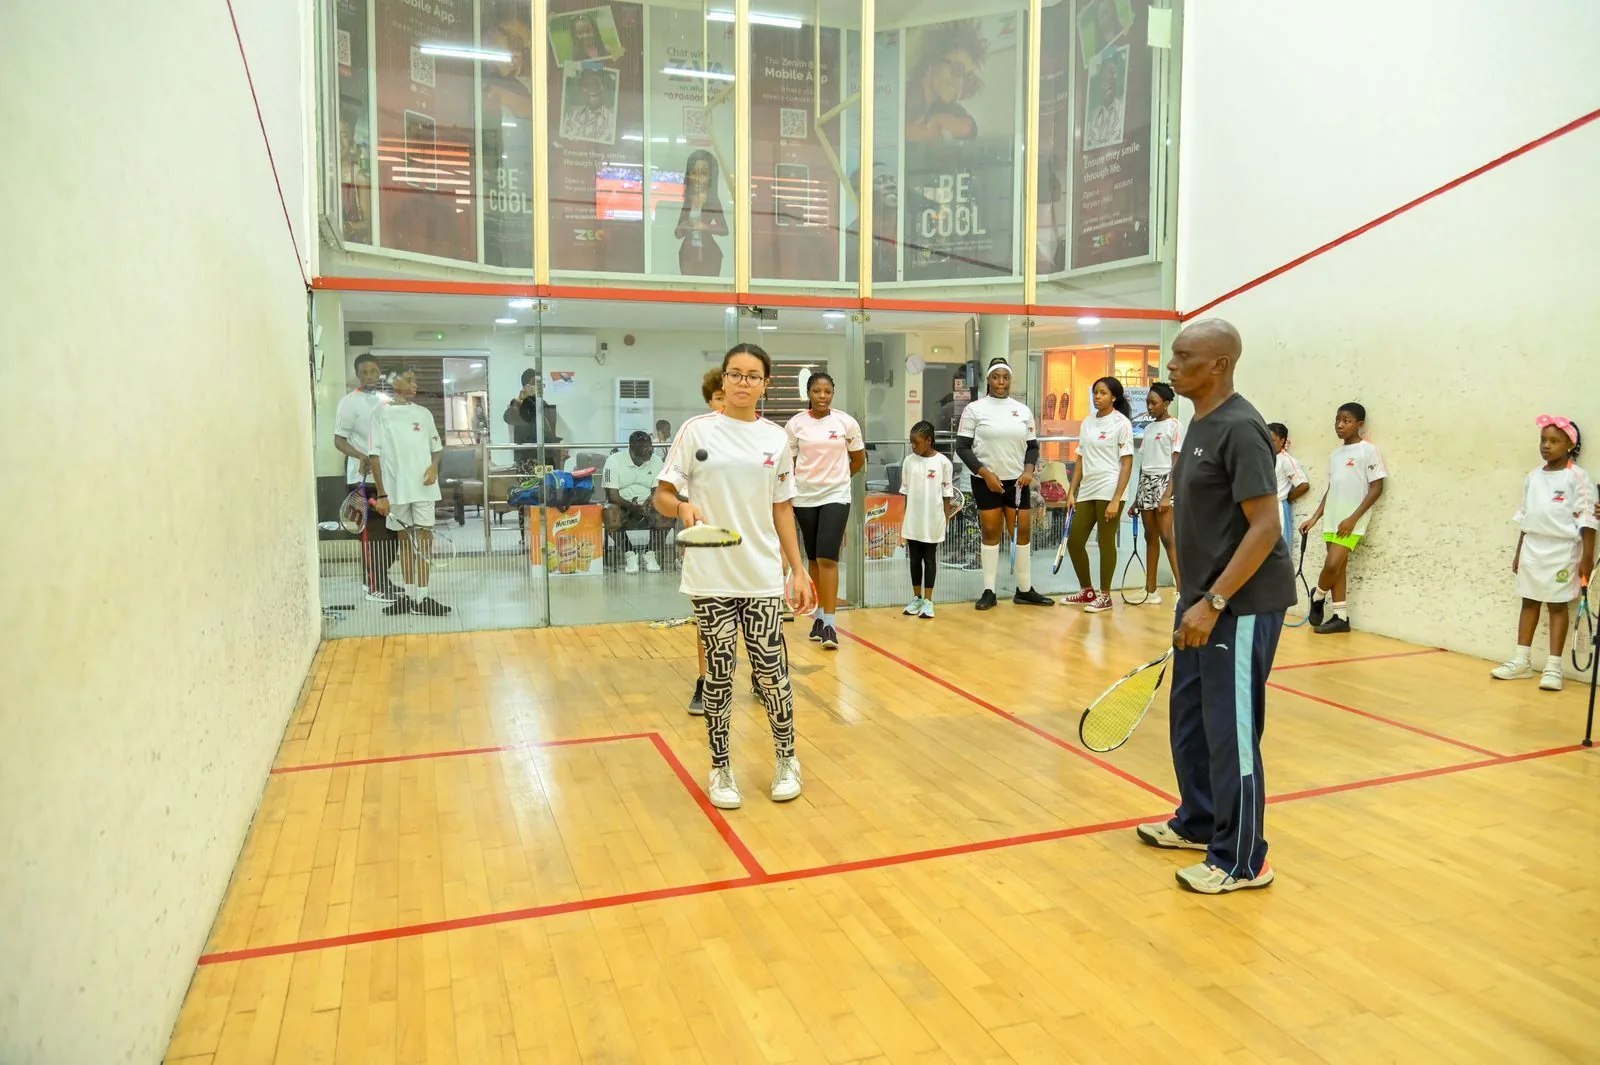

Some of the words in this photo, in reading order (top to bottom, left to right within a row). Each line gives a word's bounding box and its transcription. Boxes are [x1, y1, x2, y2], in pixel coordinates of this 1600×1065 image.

[400, 0, 432, 13] obile
[433, 5, 455, 25] App
[666, 46, 688, 57] Chat
[781, 57, 807, 69] Zenith
[764, 66, 804, 81] Mobile
[806, 71, 829, 85] Ap
[1084, 156, 1105, 169] Ensure
[1105, 151, 1121, 161] they
[1121, 142, 1141, 156] smile
[497, 167, 519, 189] BE
[1083, 167, 1109, 184] through
[939, 172, 970, 204] BE
[489, 188, 533, 215] COOL
[920, 205, 987, 238] COOL
